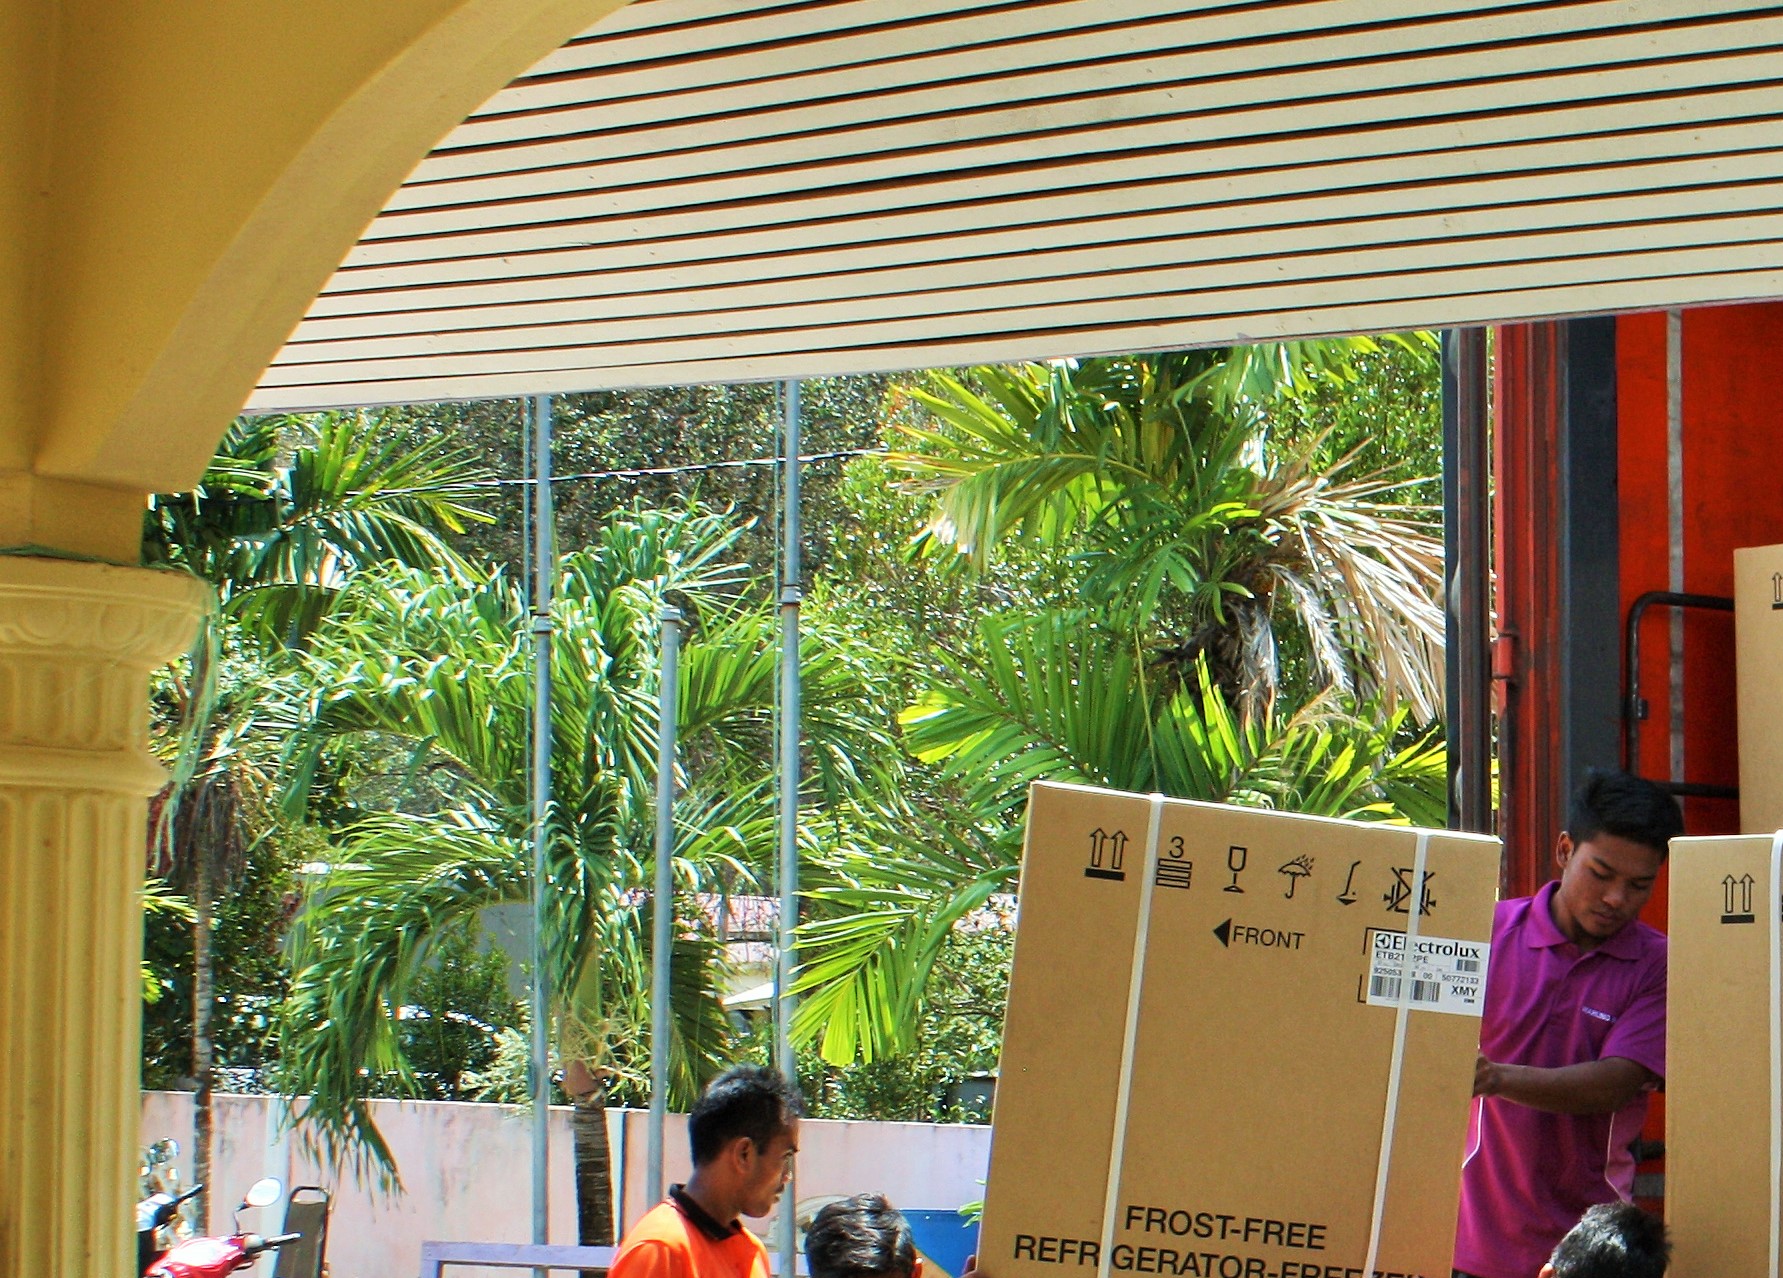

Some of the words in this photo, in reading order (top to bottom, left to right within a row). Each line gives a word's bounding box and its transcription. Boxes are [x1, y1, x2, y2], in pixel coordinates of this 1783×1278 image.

[1169, 836, 1184, 858] 3
[1233, 926, 1305, 949] FRONT
[1393, 936, 1480, 958] Elctrolux
[1376, 951, 1429, 964] ETB21PE
[1452, 985, 1478, 997] XMY
[1125, 1205, 1327, 1251] FROST-FREE
